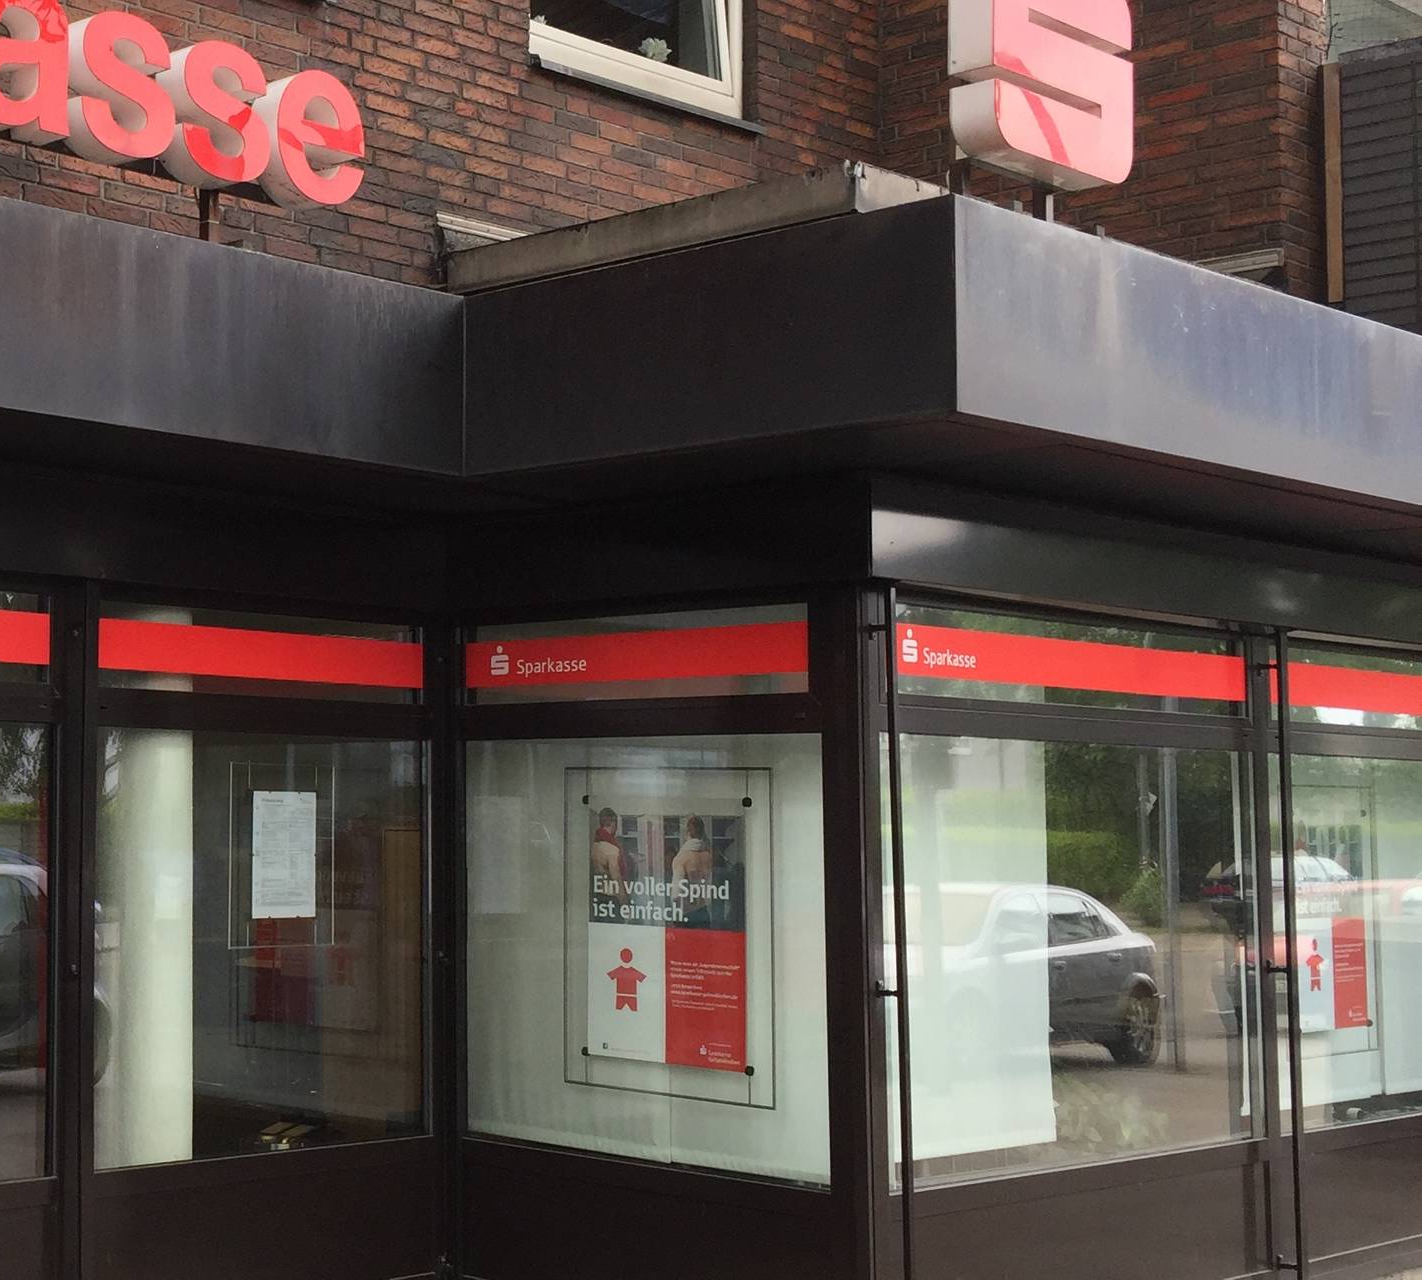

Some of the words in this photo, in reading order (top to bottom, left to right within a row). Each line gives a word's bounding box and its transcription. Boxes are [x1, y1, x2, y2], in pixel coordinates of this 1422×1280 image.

[516, 657, 587, 678] Sparkasse
[922, 647, 976, 669] Sparkasse
[593, 875, 619, 894] Ein
[623, 876, 673, 897] voller
[677, 879, 730, 903] Spind
[592, 898, 616, 918] ist
[620, 900, 689, 922] einfach.
